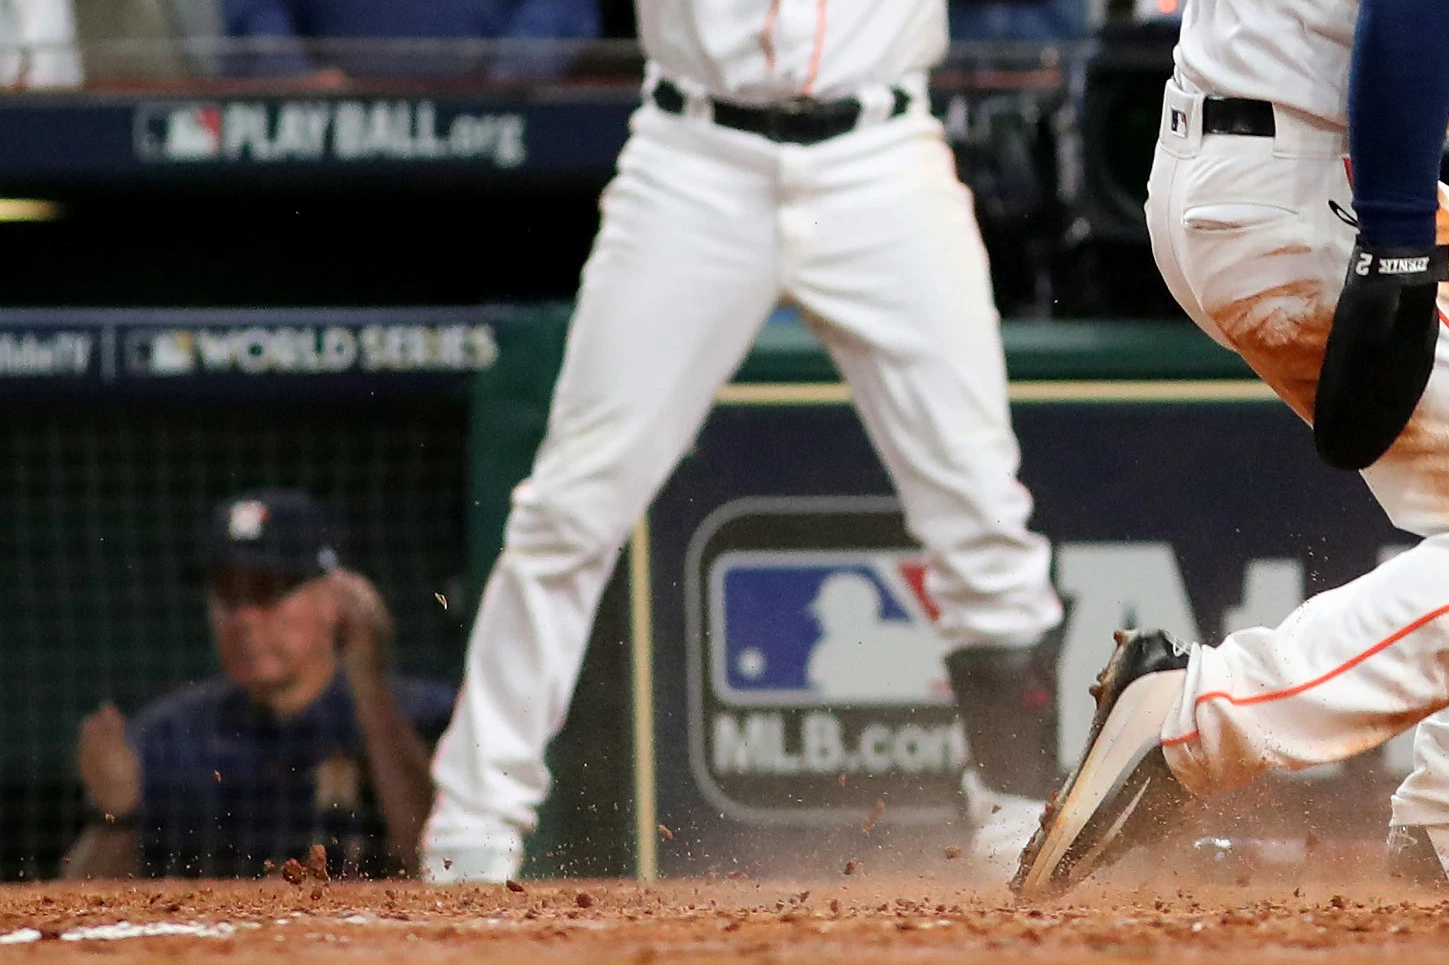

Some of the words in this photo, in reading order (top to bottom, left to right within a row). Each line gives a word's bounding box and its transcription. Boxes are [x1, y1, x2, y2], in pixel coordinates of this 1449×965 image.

[1355, 252, 1374, 276] 2
[198, 329, 358, 374] WORLD
[358, 323, 497, 372] SERIES
